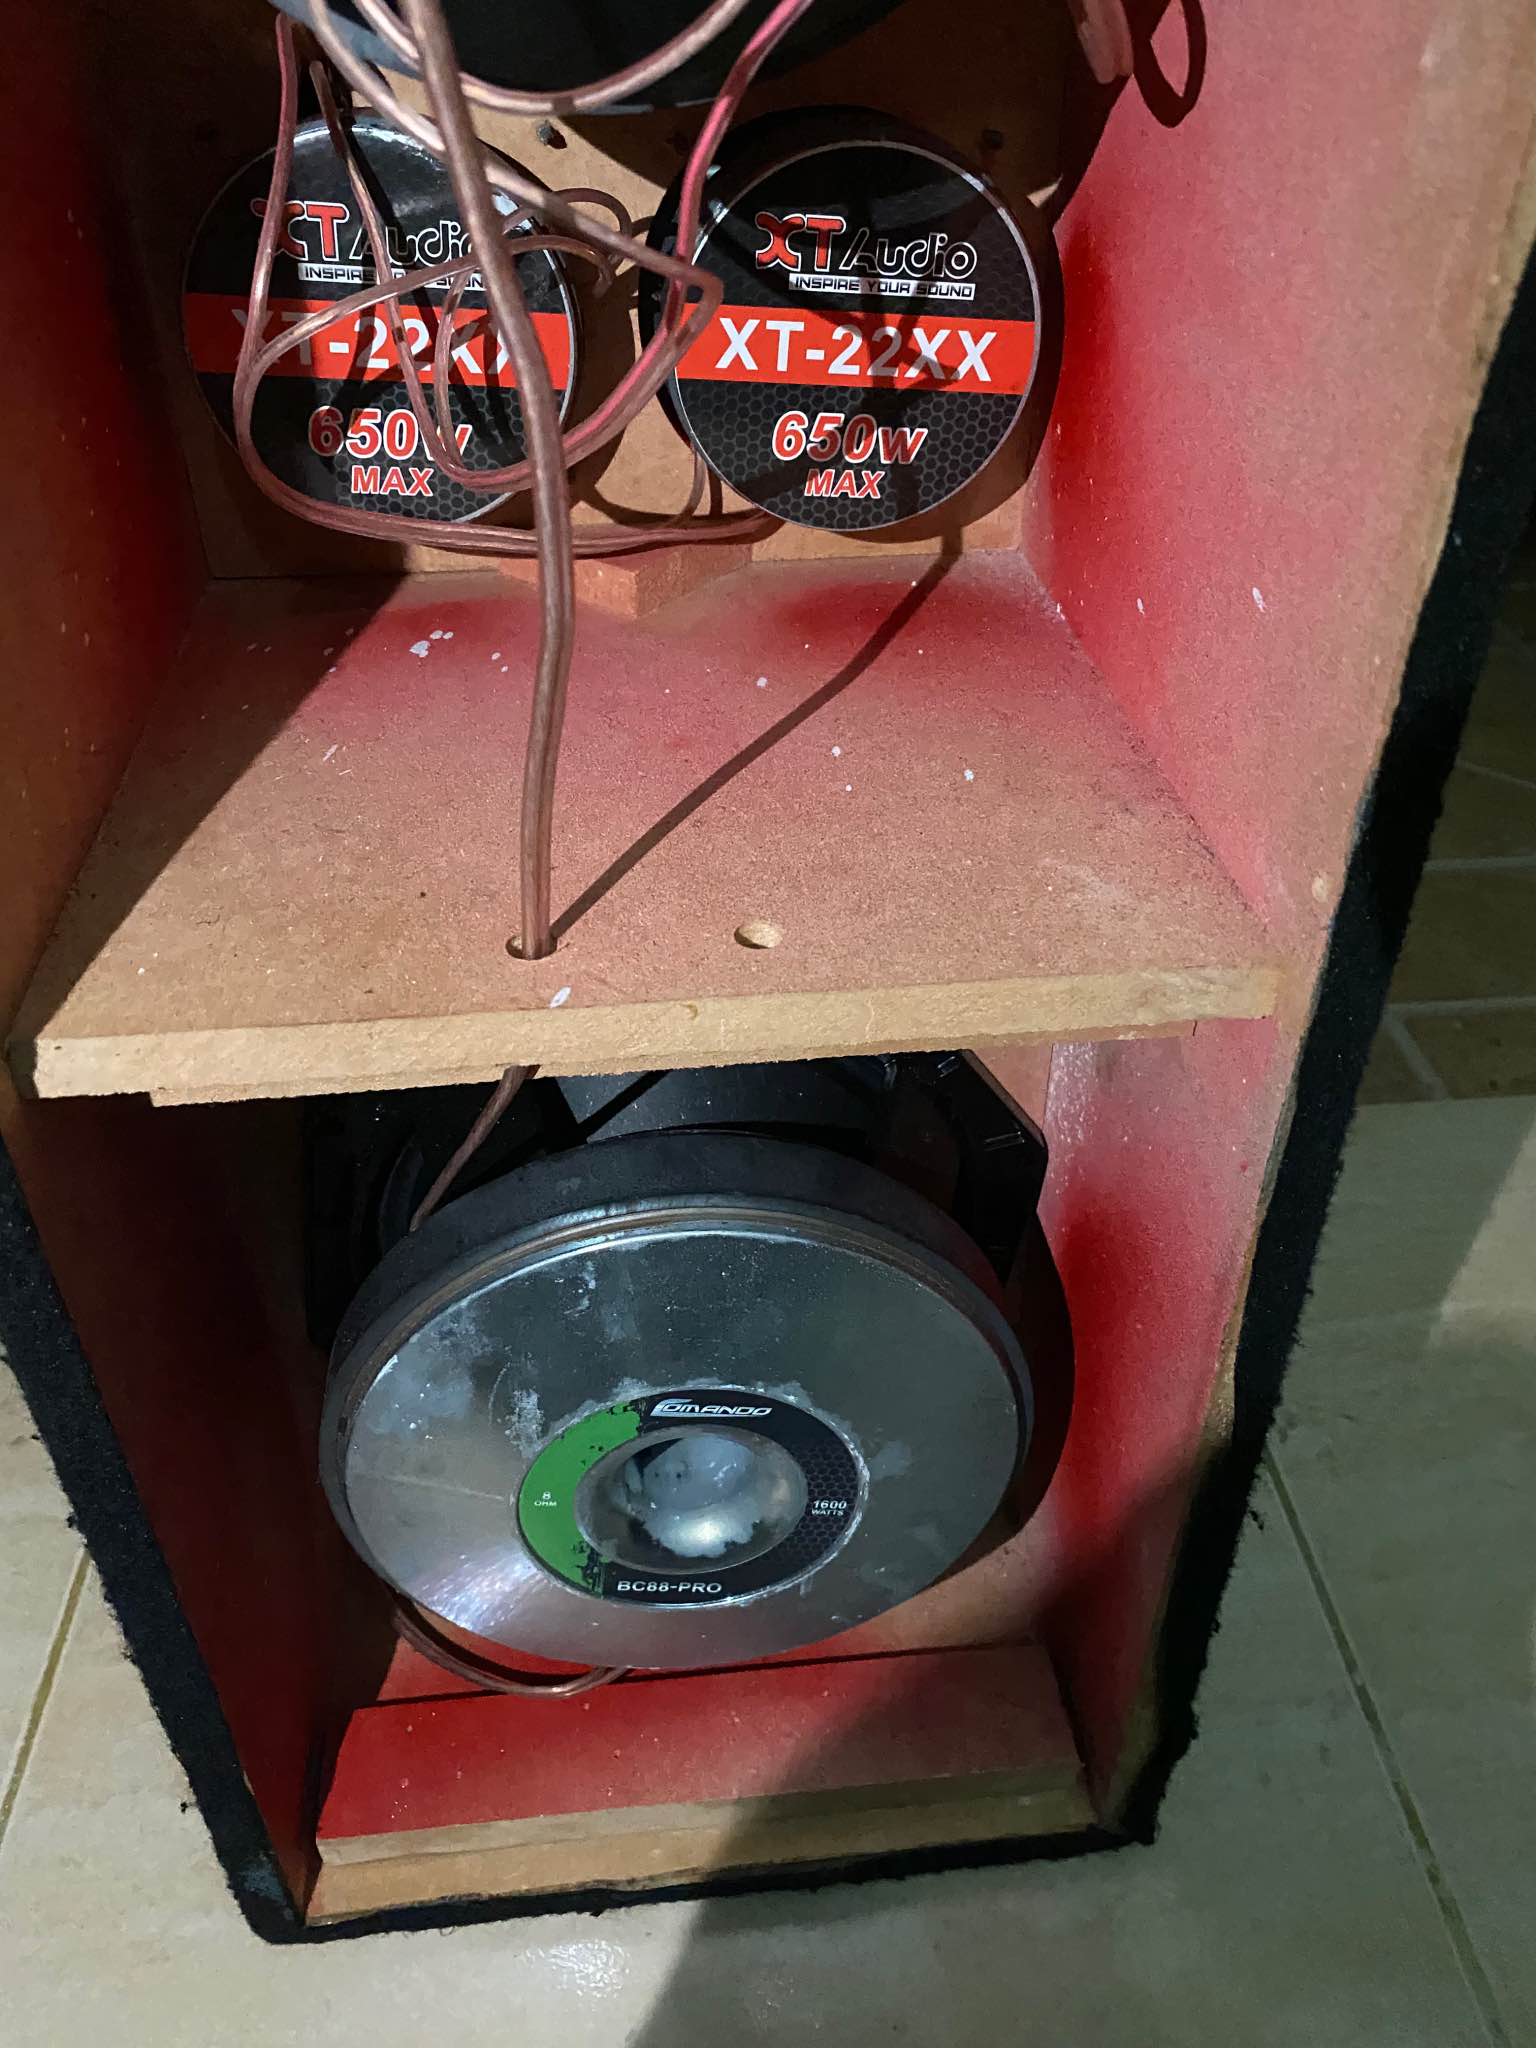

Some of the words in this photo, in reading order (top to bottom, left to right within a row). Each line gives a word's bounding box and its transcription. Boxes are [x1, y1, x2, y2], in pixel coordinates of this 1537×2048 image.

[755, 211, 846, 272] XT
[838, 227, 978, 280] Audio
[794, 276, 860, 292] INSPIRE
[867, 280, 911, 295] YOUR
[915, 284, 973, 298] SOUND
[715, 317, 998, 383] XT-22XX
[351, 465, 434, 496] MAX
[804, 468, 885, 499] MAX
[542, 1491, 551, 1500] 8
[813, 1500, 847, 1510] 1600
[811, 1509, 844, 1517] WATTS
[617, 1581, 723, 1594] BC88-PRO
